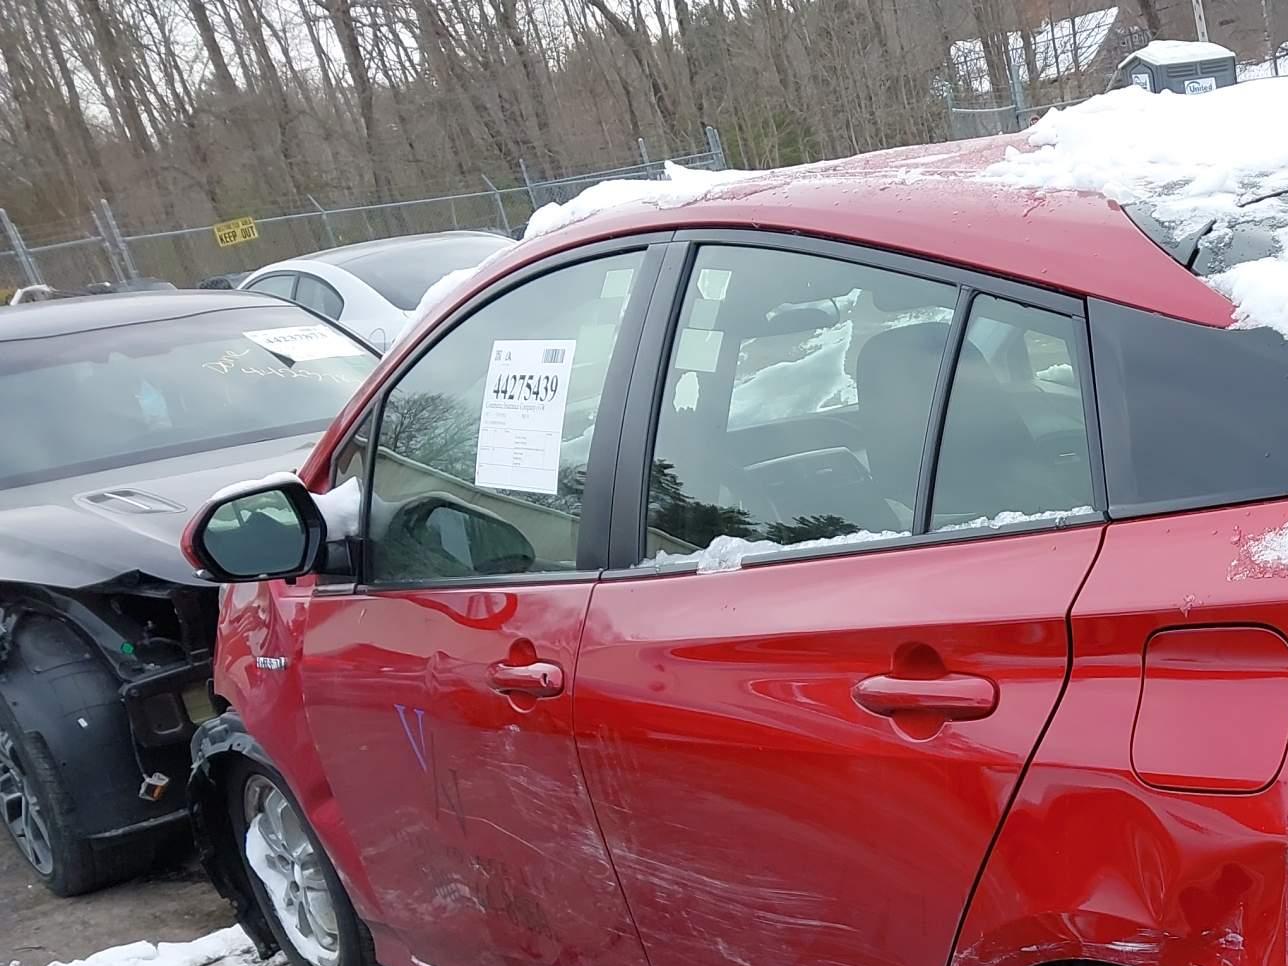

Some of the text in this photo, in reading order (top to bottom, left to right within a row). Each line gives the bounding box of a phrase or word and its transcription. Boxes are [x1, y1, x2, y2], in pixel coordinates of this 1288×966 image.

[219, 230, 237, 244] KEEP
[240, 225, 256, 239] OUT
[493, 373, 559, 402] 44275439
